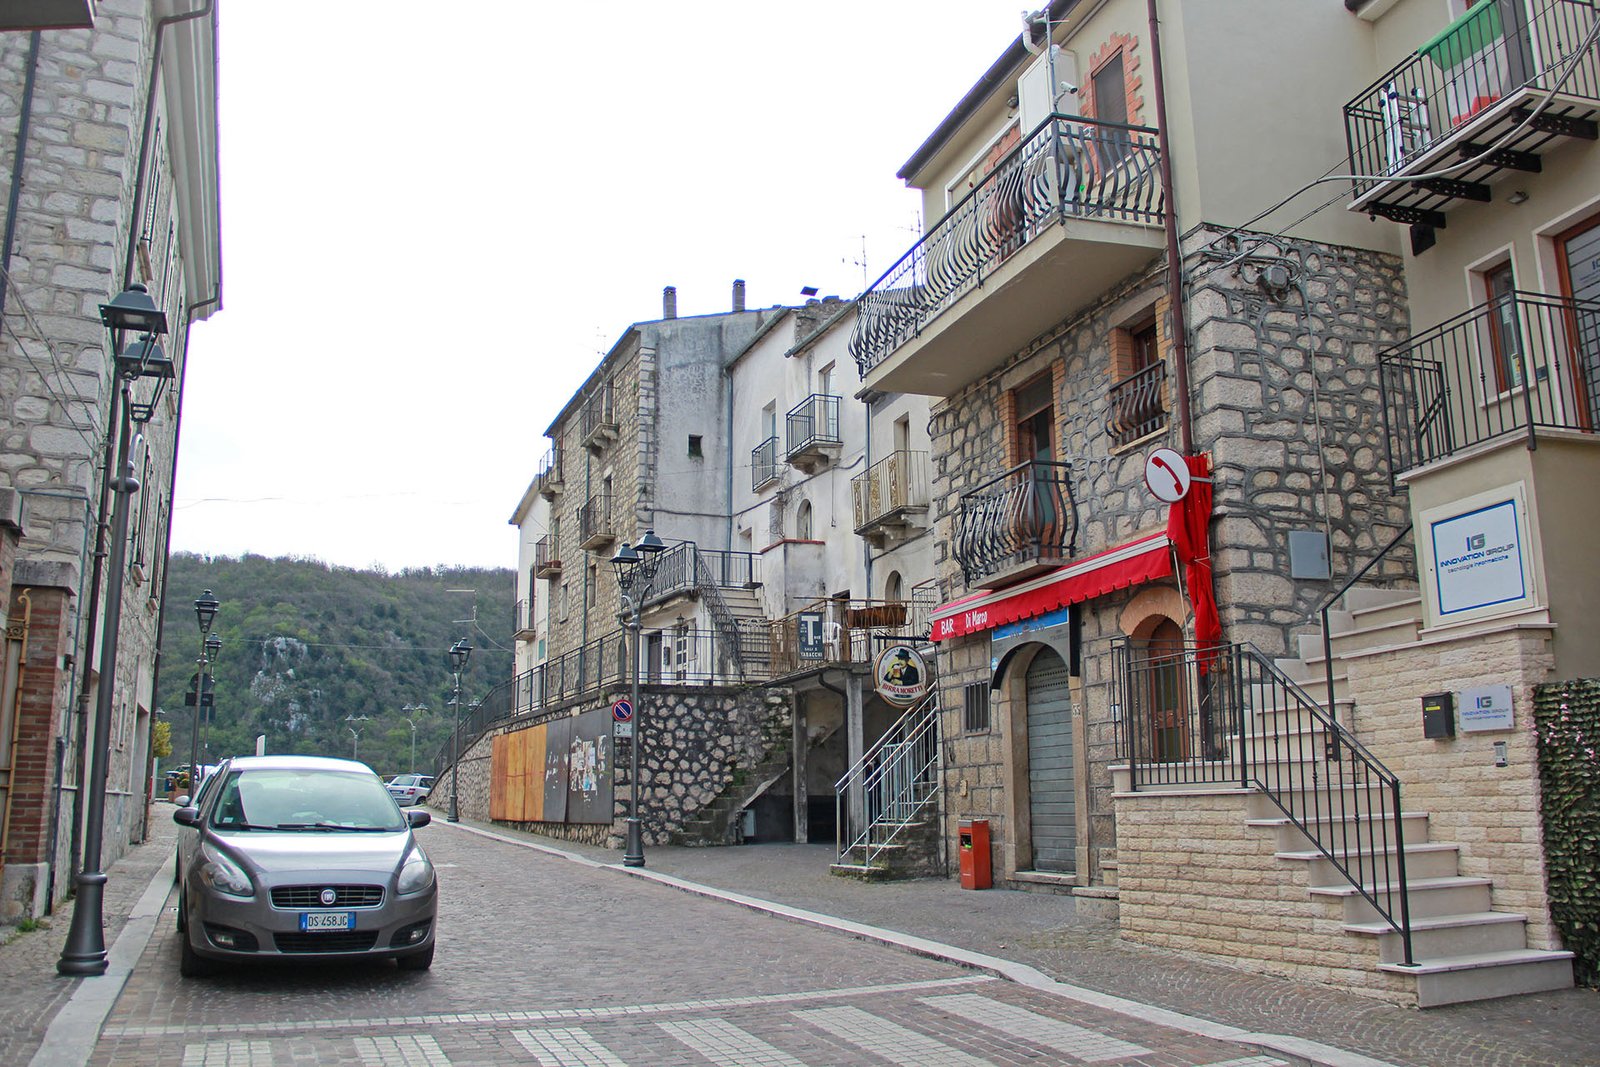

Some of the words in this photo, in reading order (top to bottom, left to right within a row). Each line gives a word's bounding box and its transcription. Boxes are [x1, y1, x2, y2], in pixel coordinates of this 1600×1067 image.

[1466, 532, 1486, 552] IG
[1440, 551, 1485, 567] INNOVATION
[1485, 543, 1515, 556] GROUP
[801, 615, 819, 645] T
[941, 618, 955, 635] BAR
[965, 612, 972, 629] Di
[972, 610, 988, 627] Marco
[882, 682, 900, 693] BIRRA
[900, 685, 924, 694] MORETTI
[1476, 696, 1492, 709] IG
[308, 916, 319, 927] DS
